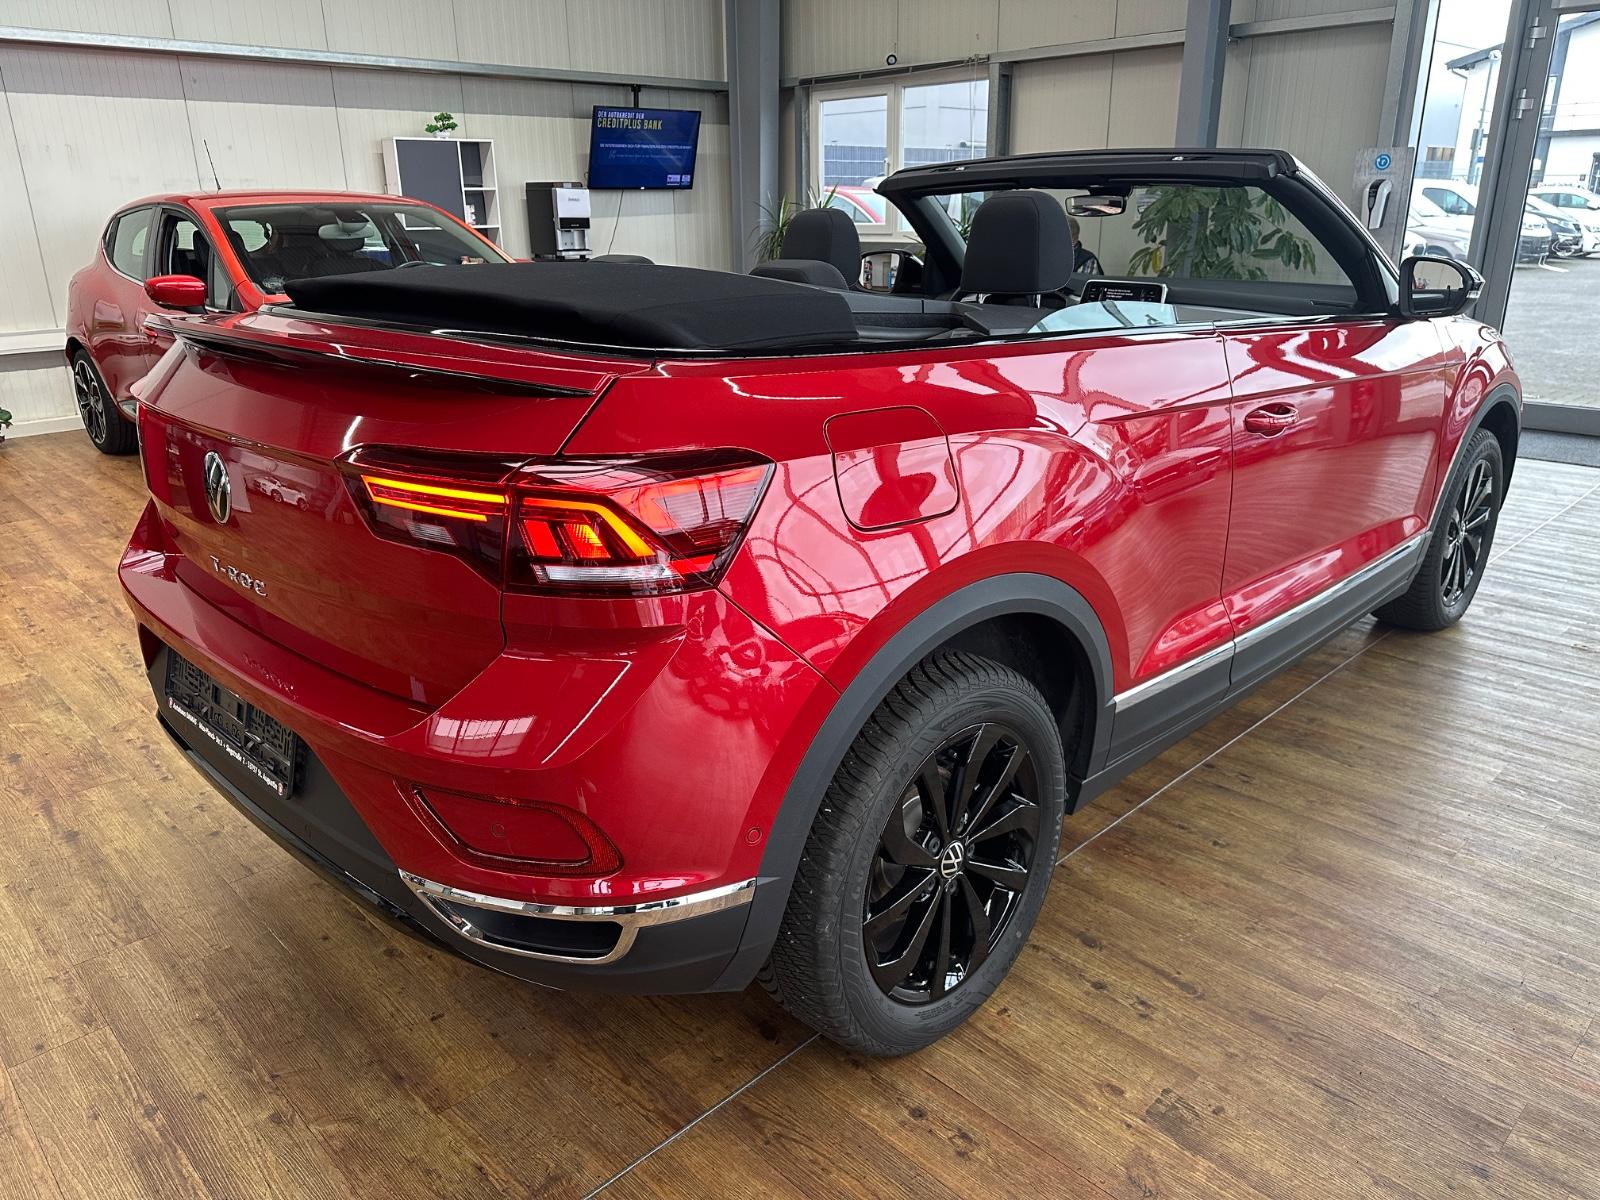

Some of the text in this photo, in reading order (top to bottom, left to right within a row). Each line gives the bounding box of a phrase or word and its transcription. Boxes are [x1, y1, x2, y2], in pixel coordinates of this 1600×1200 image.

[608, 111, 635, 119] AUTOKREDIT
[597, 117, 663, 130] CREDITPLUS BANK
[210, 555, 267, 597] T-ROC
